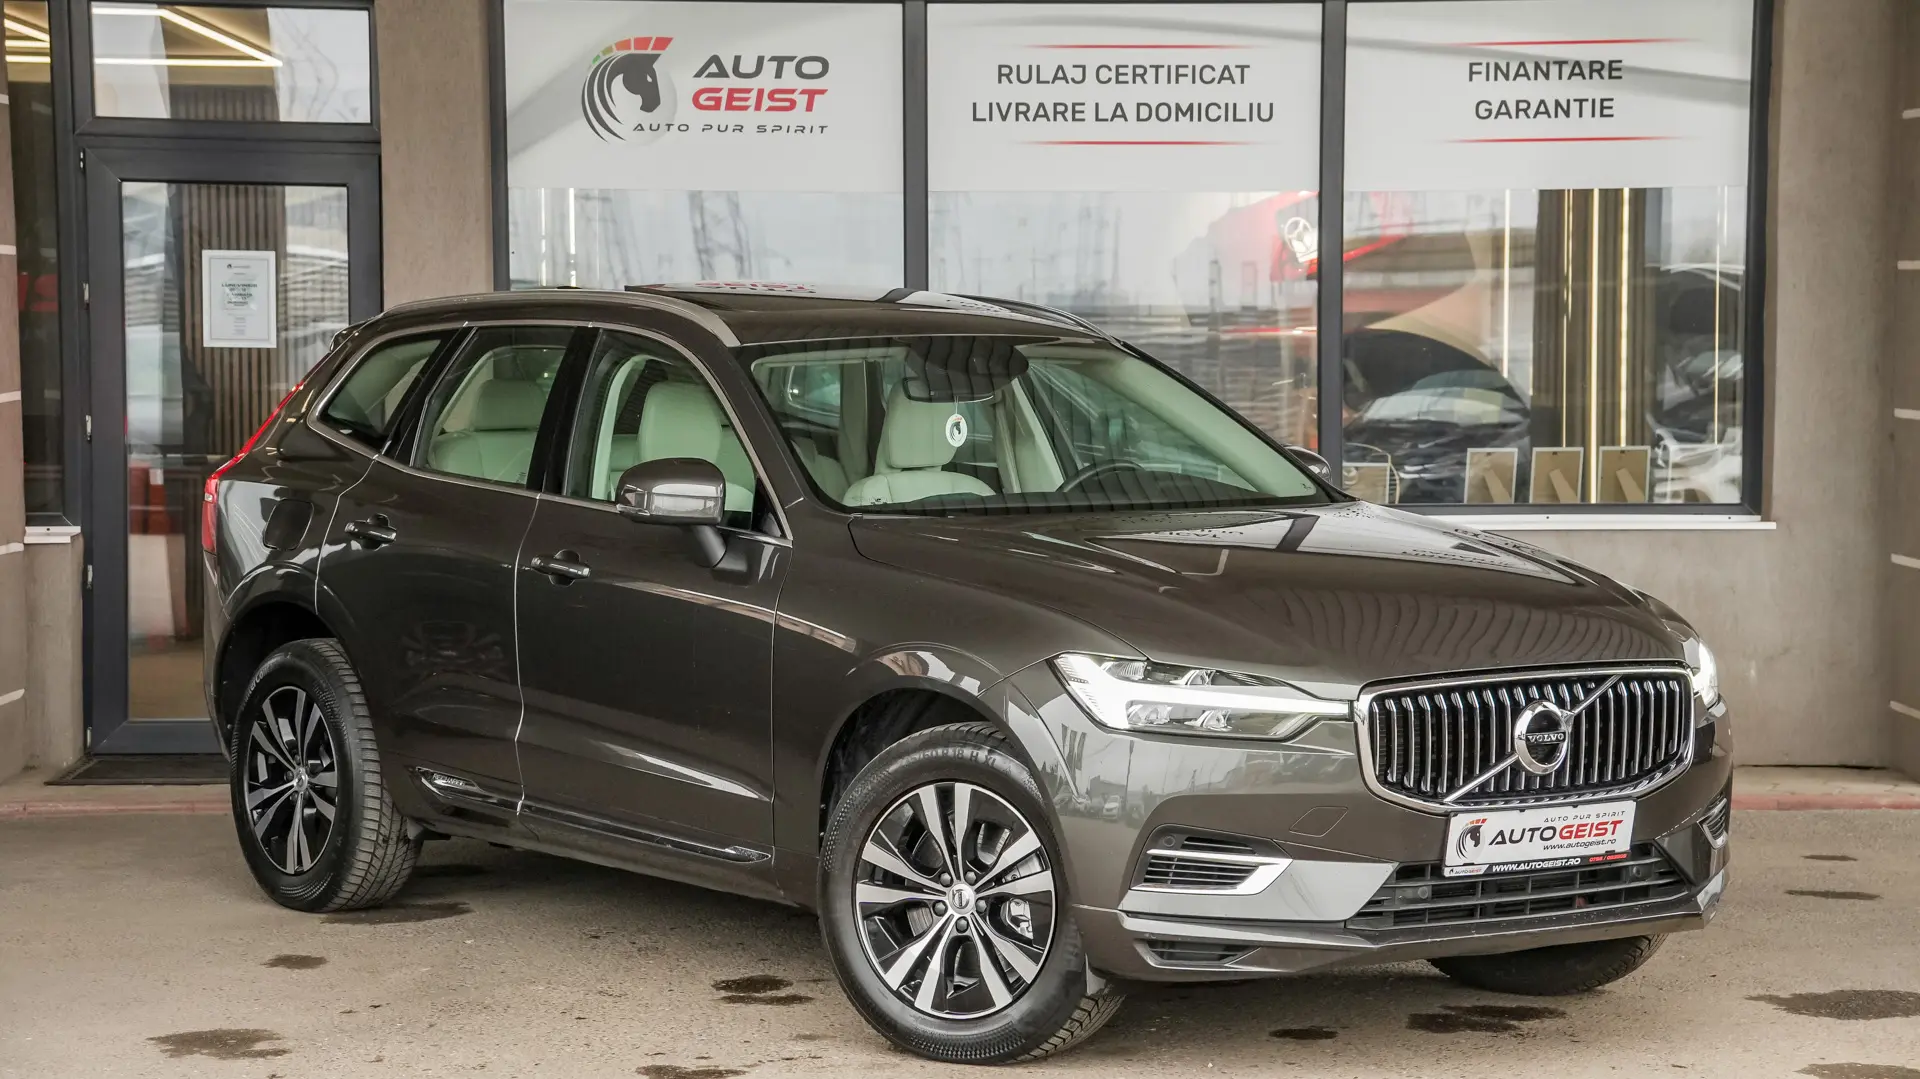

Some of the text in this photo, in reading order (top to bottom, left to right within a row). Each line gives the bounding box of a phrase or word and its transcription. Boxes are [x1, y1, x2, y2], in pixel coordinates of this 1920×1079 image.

[693, 55, 830, 80] AUTO
[997, 64, 1251, 85] RULAJ CERTIFICAT
[1468, 59, 1623, 82] FINANTARE
[691, 87, 828, 112] GEIST
[1474, 97, 1615, 120] GARANTIE
[972, 102, 1274, 123] LIVRARE LA DOMICILIU
[633, 123, 828, 135] AUTO PUR SPIRIT
[1527, 732, 1564, 743] VOLVO
[1543, 810, 1626, 823] AUTO PUR SPIRIT
[1488, 819, 1624, 846] AUTOGEIST
[1543, 838, 1617, 851] www.autogeist.ro
[1492, 857, 1582, 873] WWW.AUTOGEIST.RO
